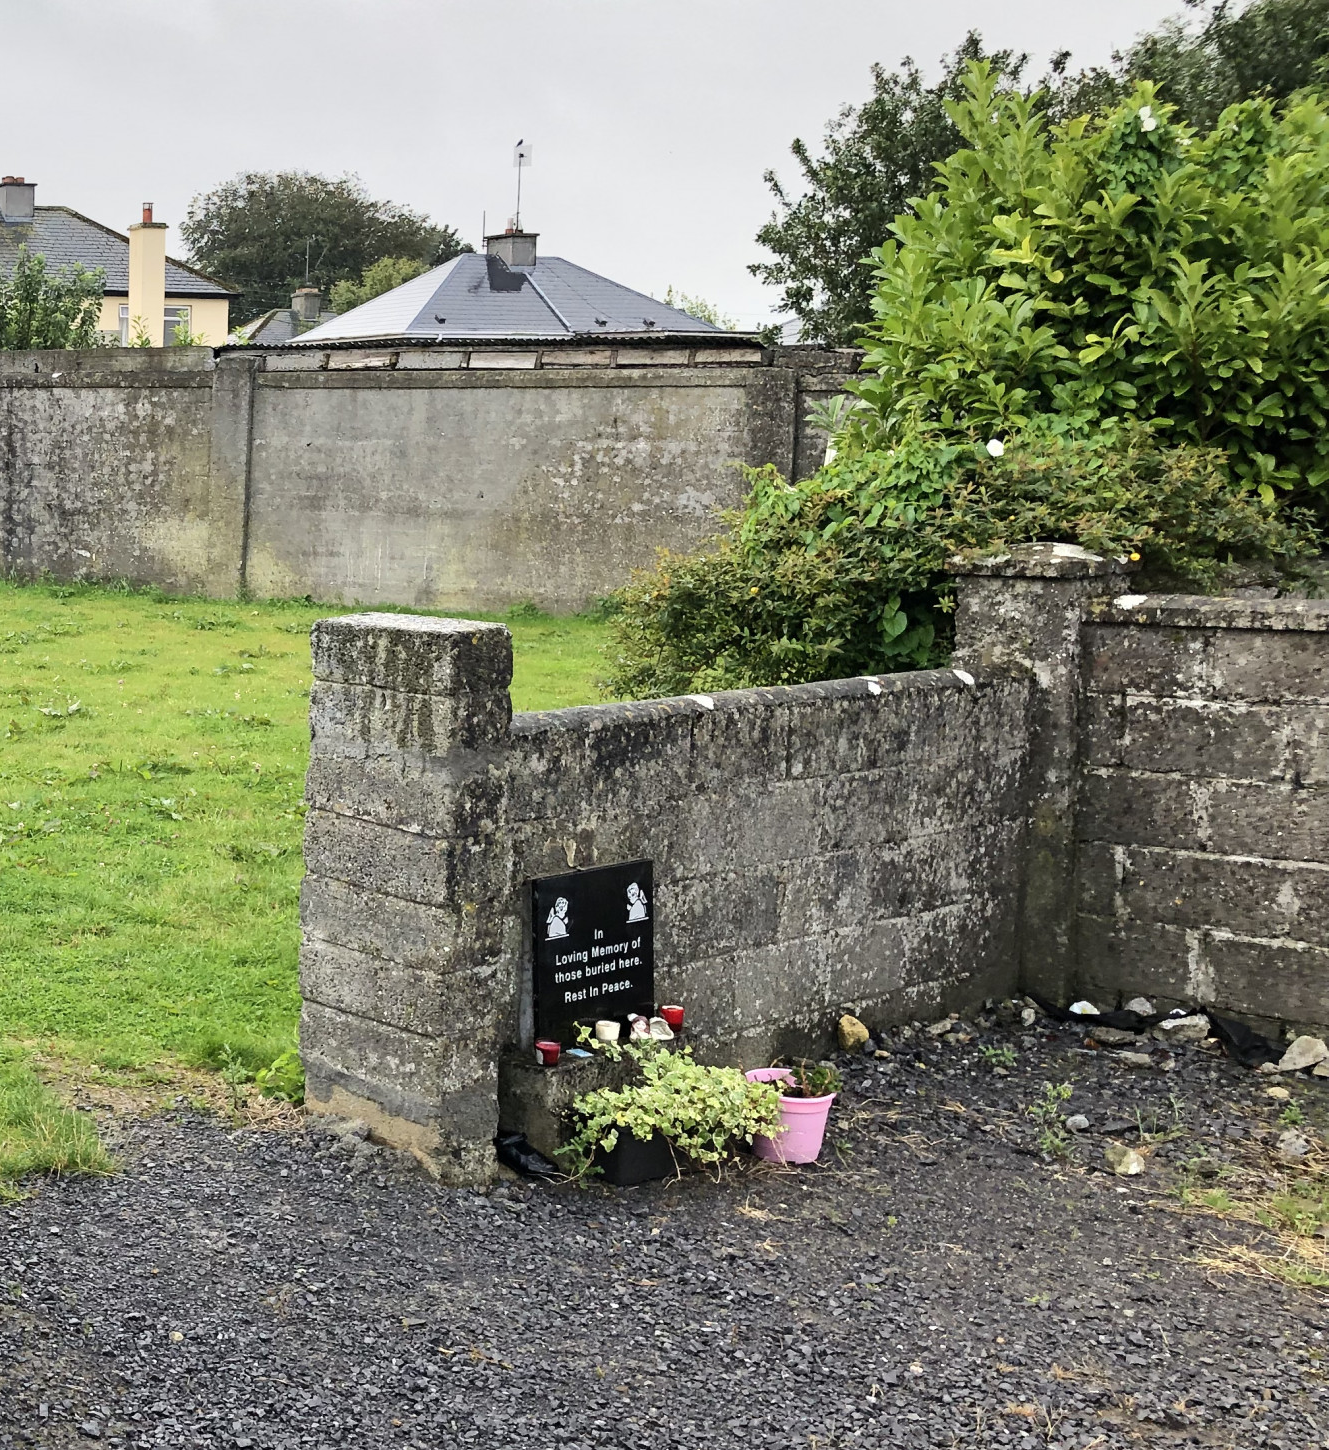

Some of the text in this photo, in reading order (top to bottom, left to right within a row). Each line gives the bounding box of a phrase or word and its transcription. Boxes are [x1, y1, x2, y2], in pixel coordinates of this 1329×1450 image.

[594, 928, 604, 940] In
[556, 936, 640, 966] Loving Memory of
[555, 956, 642, 984] those buried here.
[564, 980, 633, 1004] Rest In Peace.
